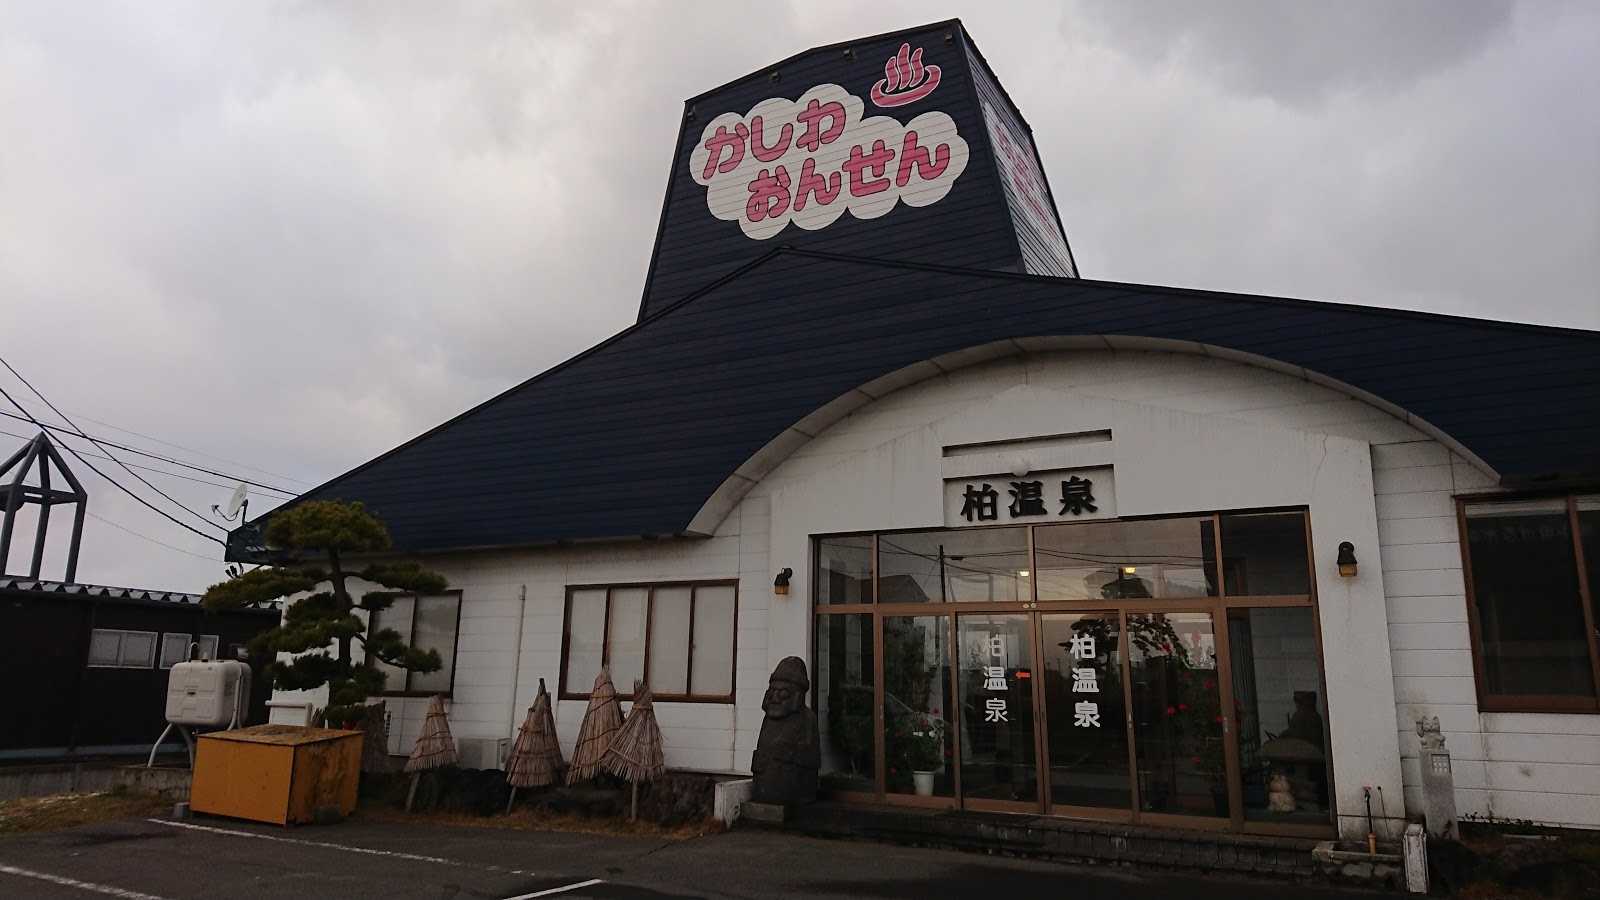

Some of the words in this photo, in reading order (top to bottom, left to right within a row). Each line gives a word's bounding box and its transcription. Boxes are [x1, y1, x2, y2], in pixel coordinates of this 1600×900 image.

[701, 98, 847, 181] かしわ
[745, 130, 951, 222] おんせん
[960, 475, 1098, 522] 柏温泉
[1069, 632, 1101, 728] 柏温泉
